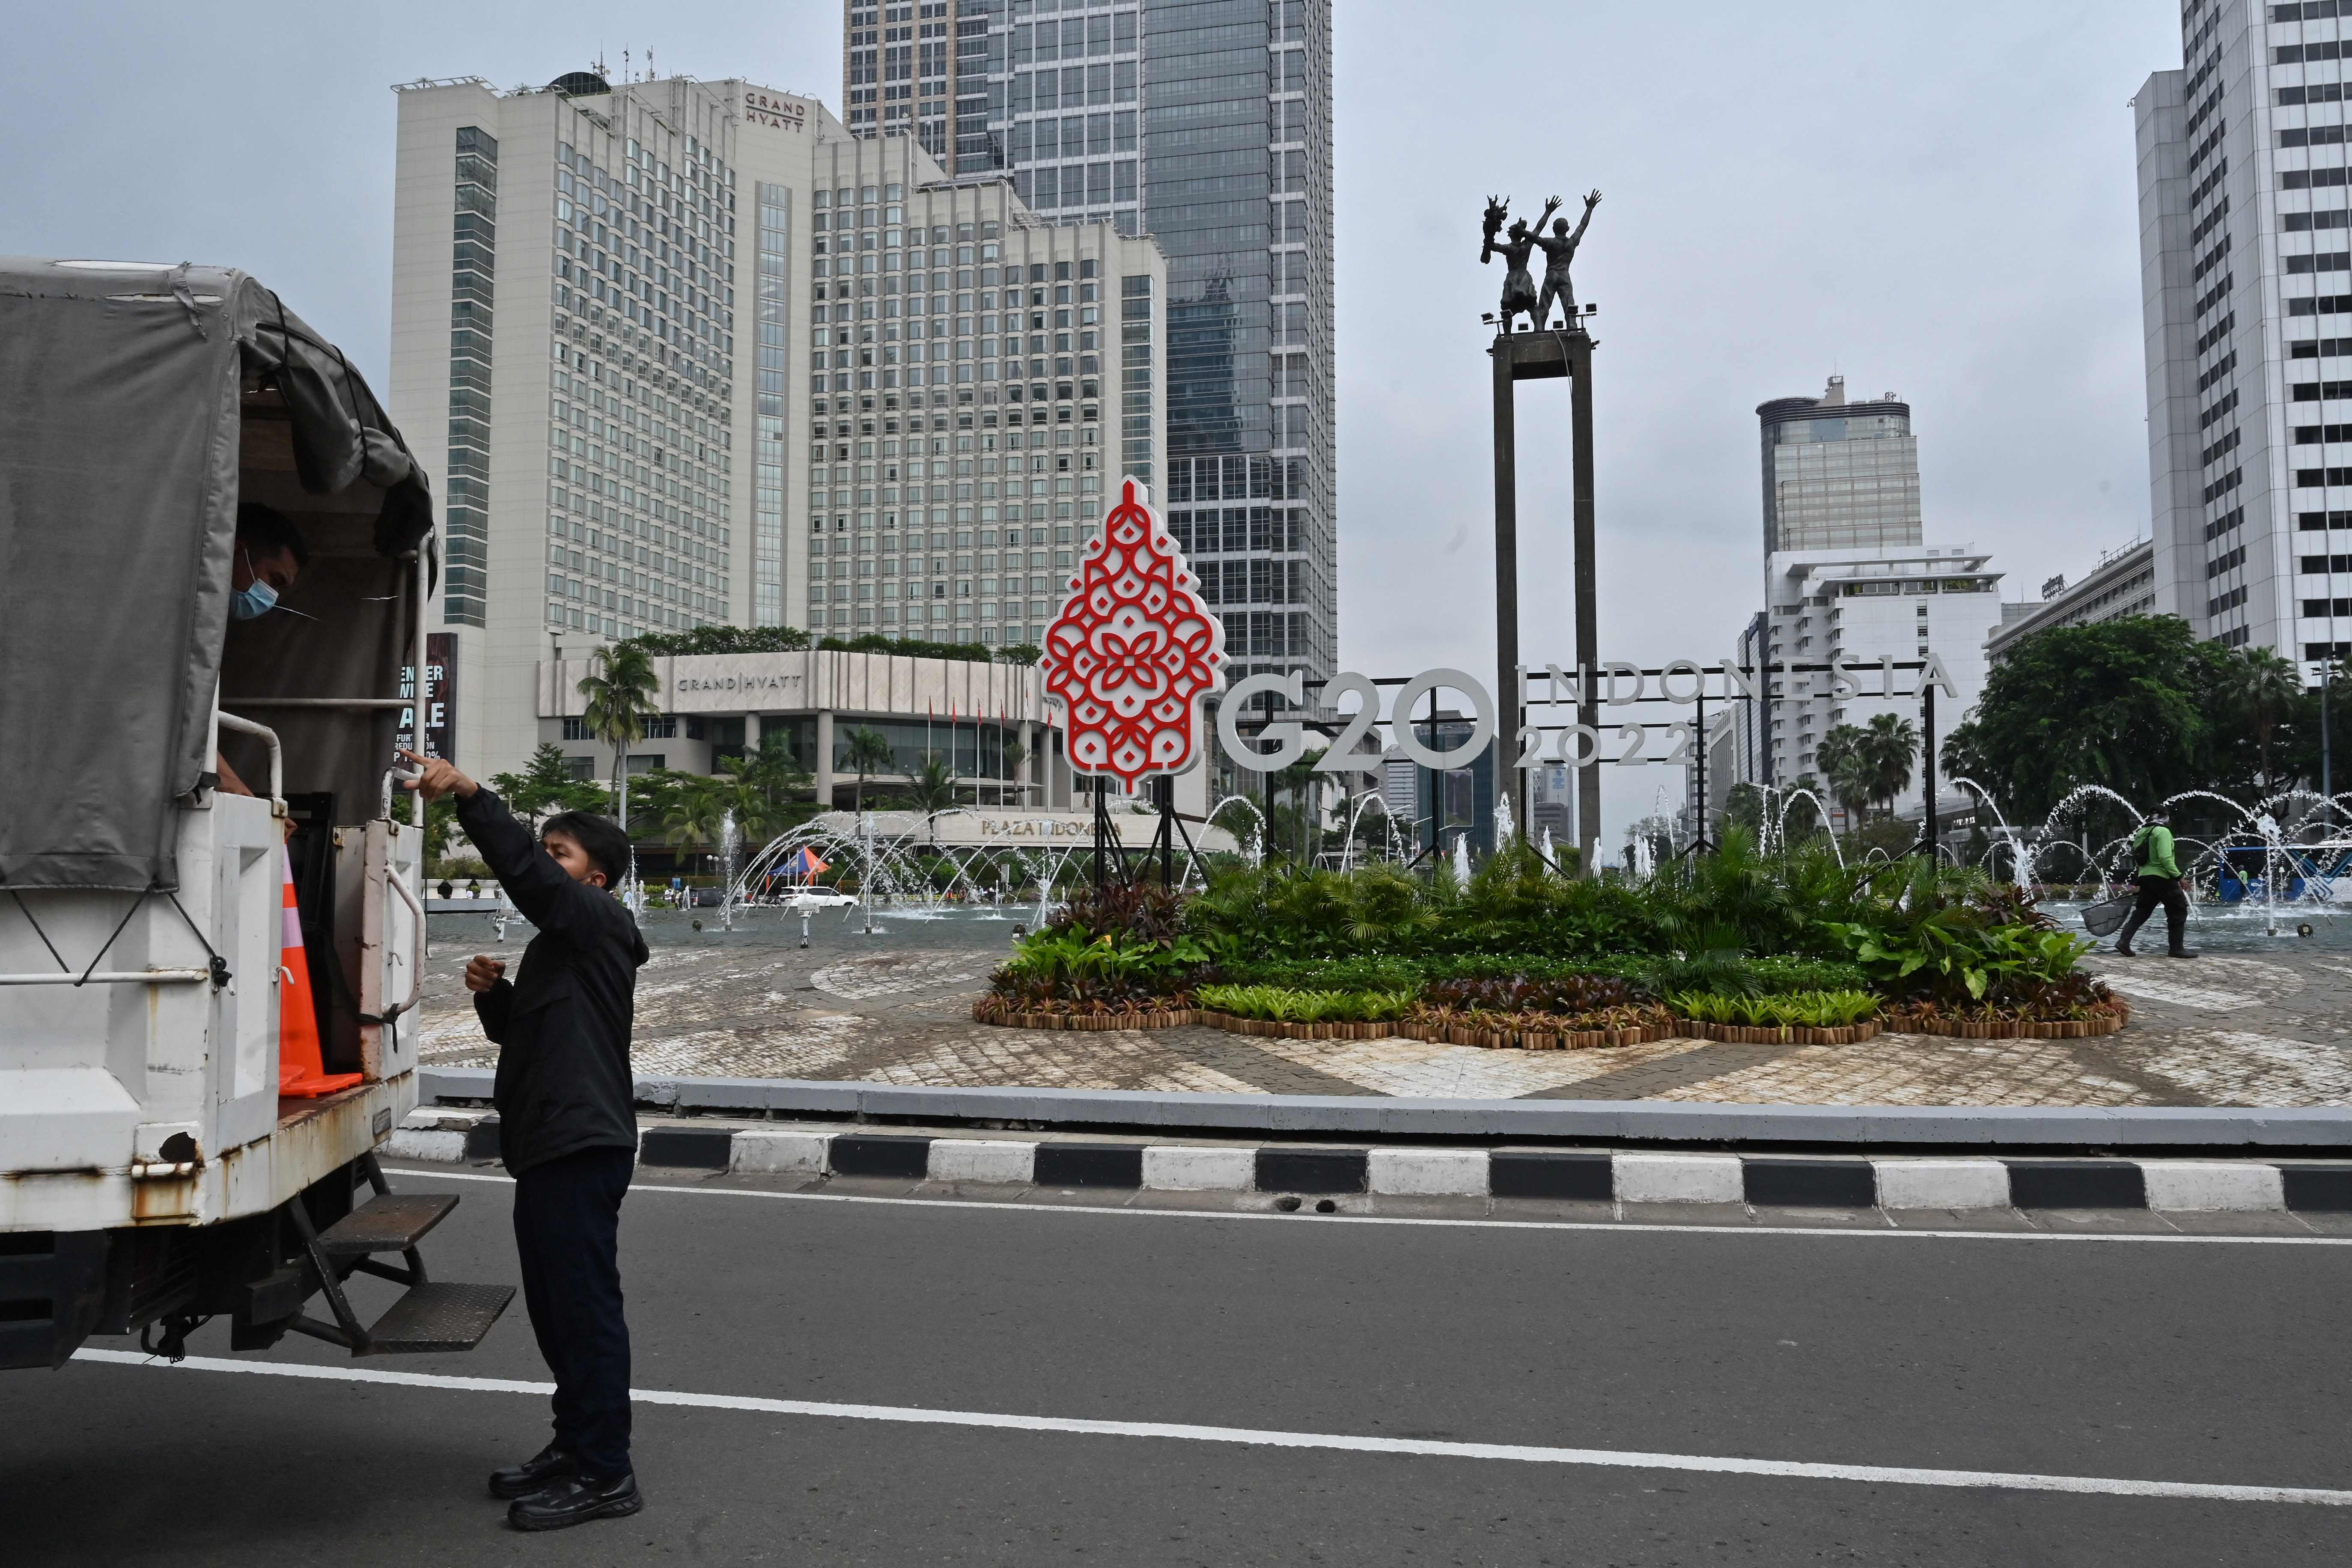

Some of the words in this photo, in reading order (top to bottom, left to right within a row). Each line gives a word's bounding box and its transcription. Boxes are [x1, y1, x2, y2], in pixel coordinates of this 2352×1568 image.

[746, 92, 805, 116] GRAND
[747, 110, 803, 133] HYATT
[678, 678, 736, 691] GRAND
[744, 675, 801, 688] HYATT
[1515, 652, 1959, 708] INDONESIA
[1217, 668, 1495, 772] G20
[1512, 721, 1698, 768] 2022
[982, 820, 1035, 835] PLAZA
